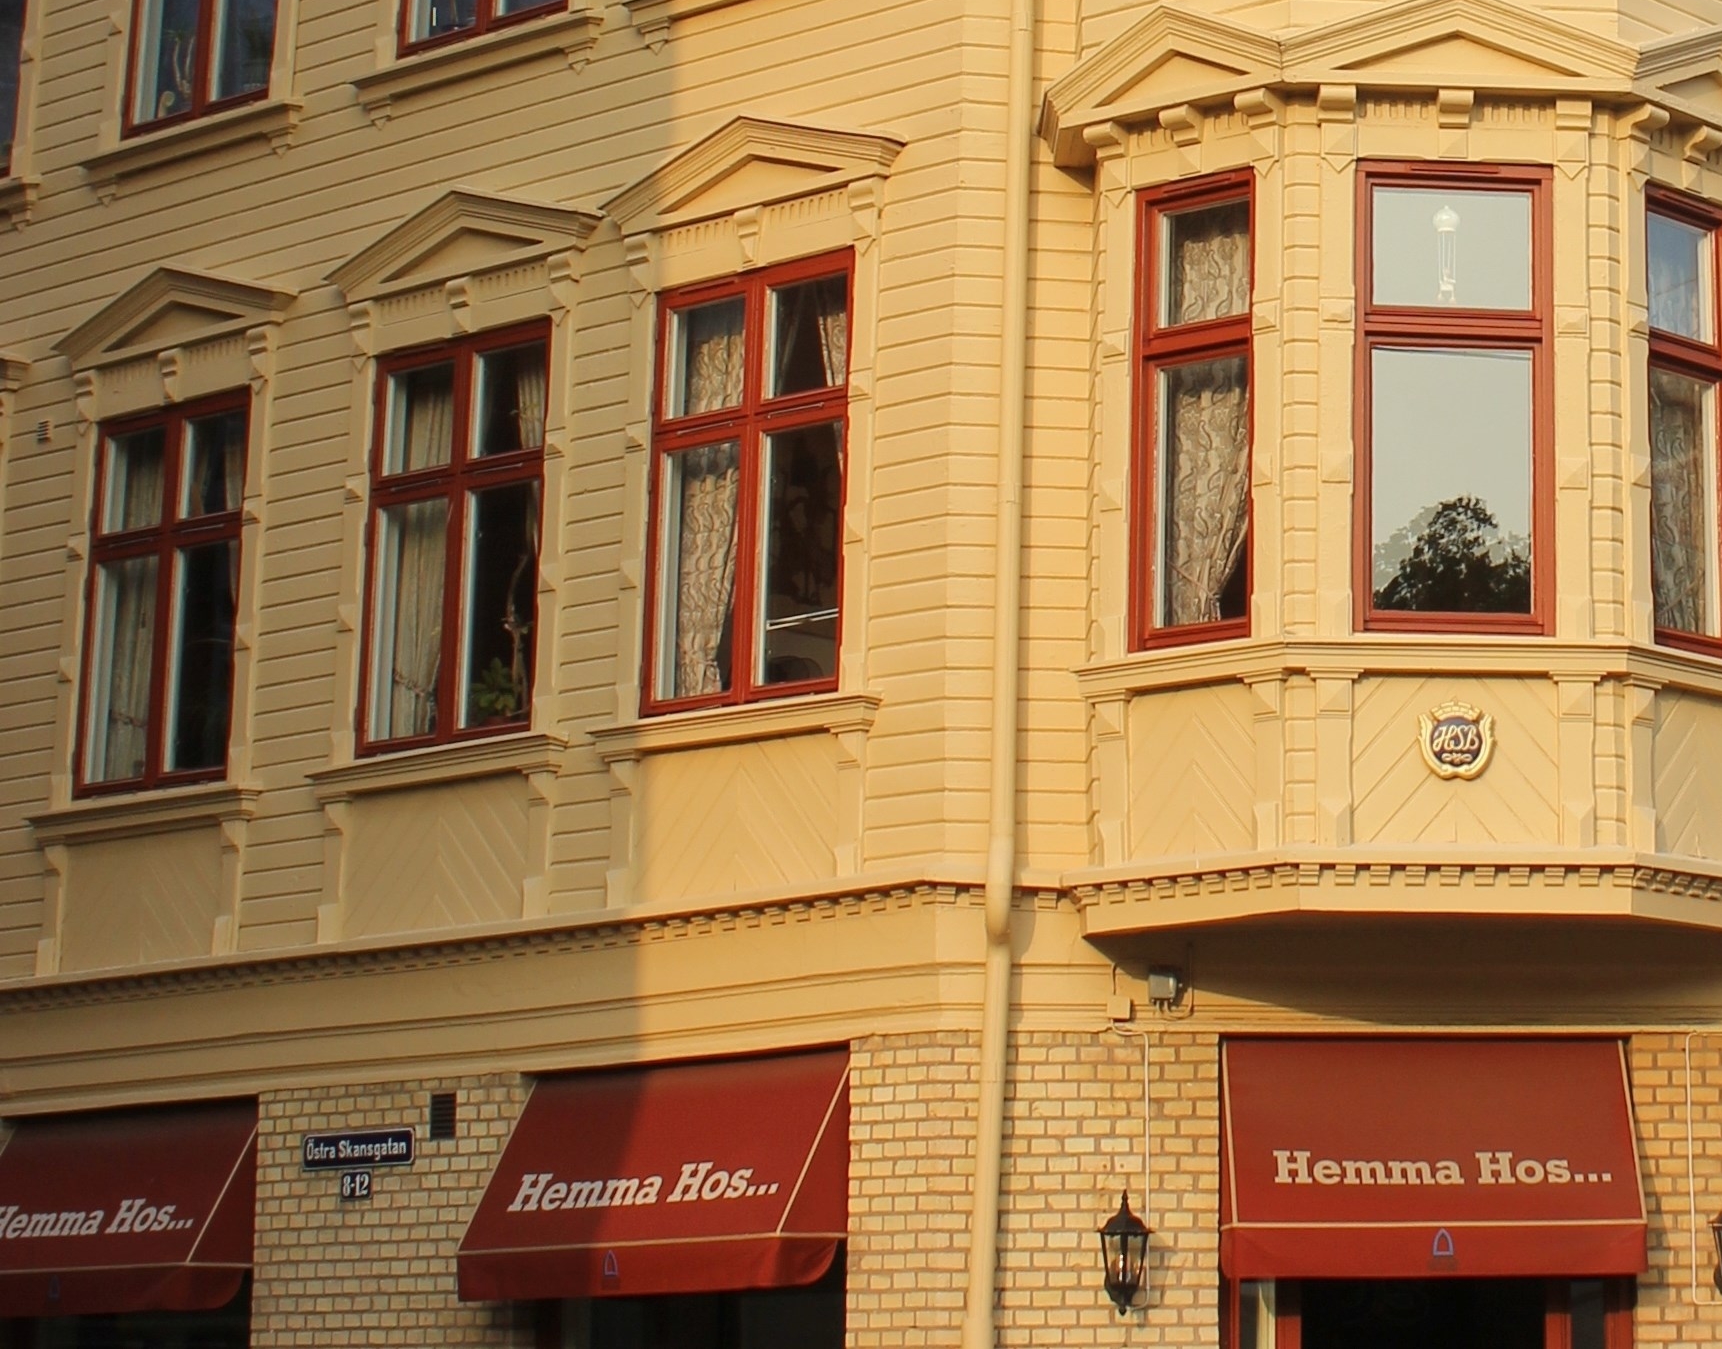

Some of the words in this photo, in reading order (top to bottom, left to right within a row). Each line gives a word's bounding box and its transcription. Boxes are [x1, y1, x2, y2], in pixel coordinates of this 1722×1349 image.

[306, 1138, 337, 1161] Östra
[338, 1137, 407, 1161] Skansgatan
[1272, 1149, 1465, 1186] Hemma
[342, 1173, 370, 1197] 8-12
[506, 1173, 663, 1212] Hemma
